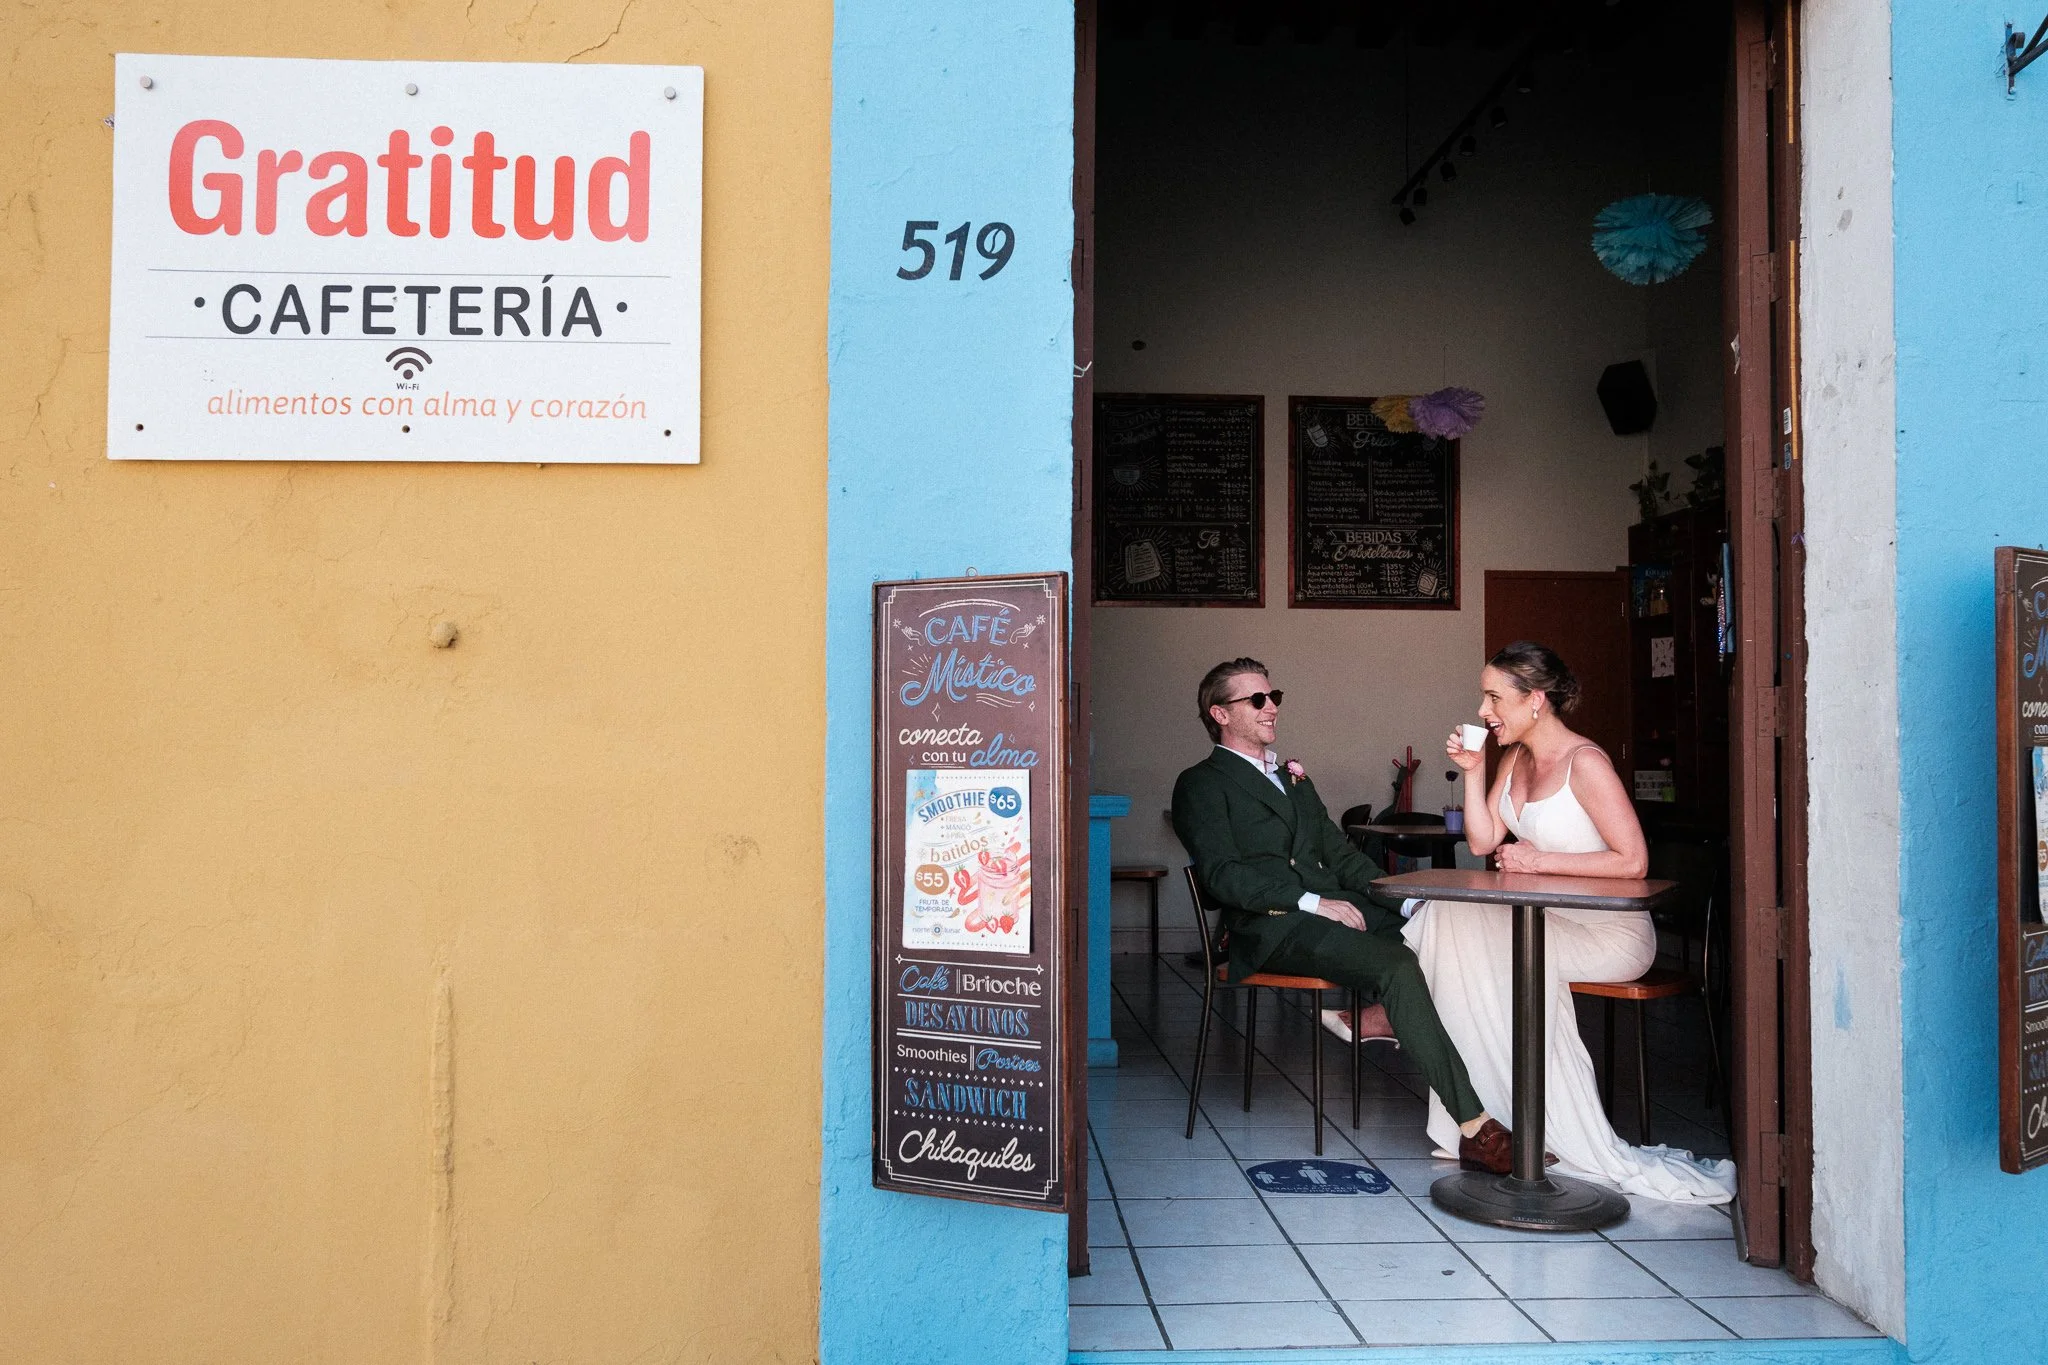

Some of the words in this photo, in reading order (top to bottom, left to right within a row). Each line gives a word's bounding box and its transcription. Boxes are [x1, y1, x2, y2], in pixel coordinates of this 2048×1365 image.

[168, 119, 651, 243] Gratitud
[896, 220, 1015, 281] 519
[221, 274, 602, 337] CAFETERÍA
[396, 383, 420, 391] Wi-Fi
[208, 389, 351, 416] alimentos
[362, 395, 414, 416] con
[424, 391, 496, 418] alma
[506, 399, 521, 423] y
[530, 393, 647, 419] corazón
[1197, 529, 1221, 549] Té
[1331, 544, 1414, 562] Embotelladas
[1346, 531, 1402, 544] BEBIDAS
[925, 606, 1012, 646] CAFÉ
[901, 648, 1036, 707] Místico
[2022, 700, 2048, 718] cone
[899, 722, 983, 745] conecta
[922, 752, 949, 763] con
[953, 751, 966, 762] tu
[969, 733, 1040, 767] alma
[917, 791, 985, 823] SMOOTHIE
[989, 793, 1018, 811] $65
[930, 835, 989, 862] batidos
[916, 871, 944, 888] $55
[900, 964, 950, 995] Café
[962, 973, 1041, 996] Brioche
[904, 1000, 1030, 1037] DESAYUNOS
[897, 1044, 967, 1064] Smoothies
[975, 1047, 1041, 1072] Postres
[904, 1076, 1027, 1121] SANDWICH
[898, 1127, 1036, 1181] Chilaquiles
